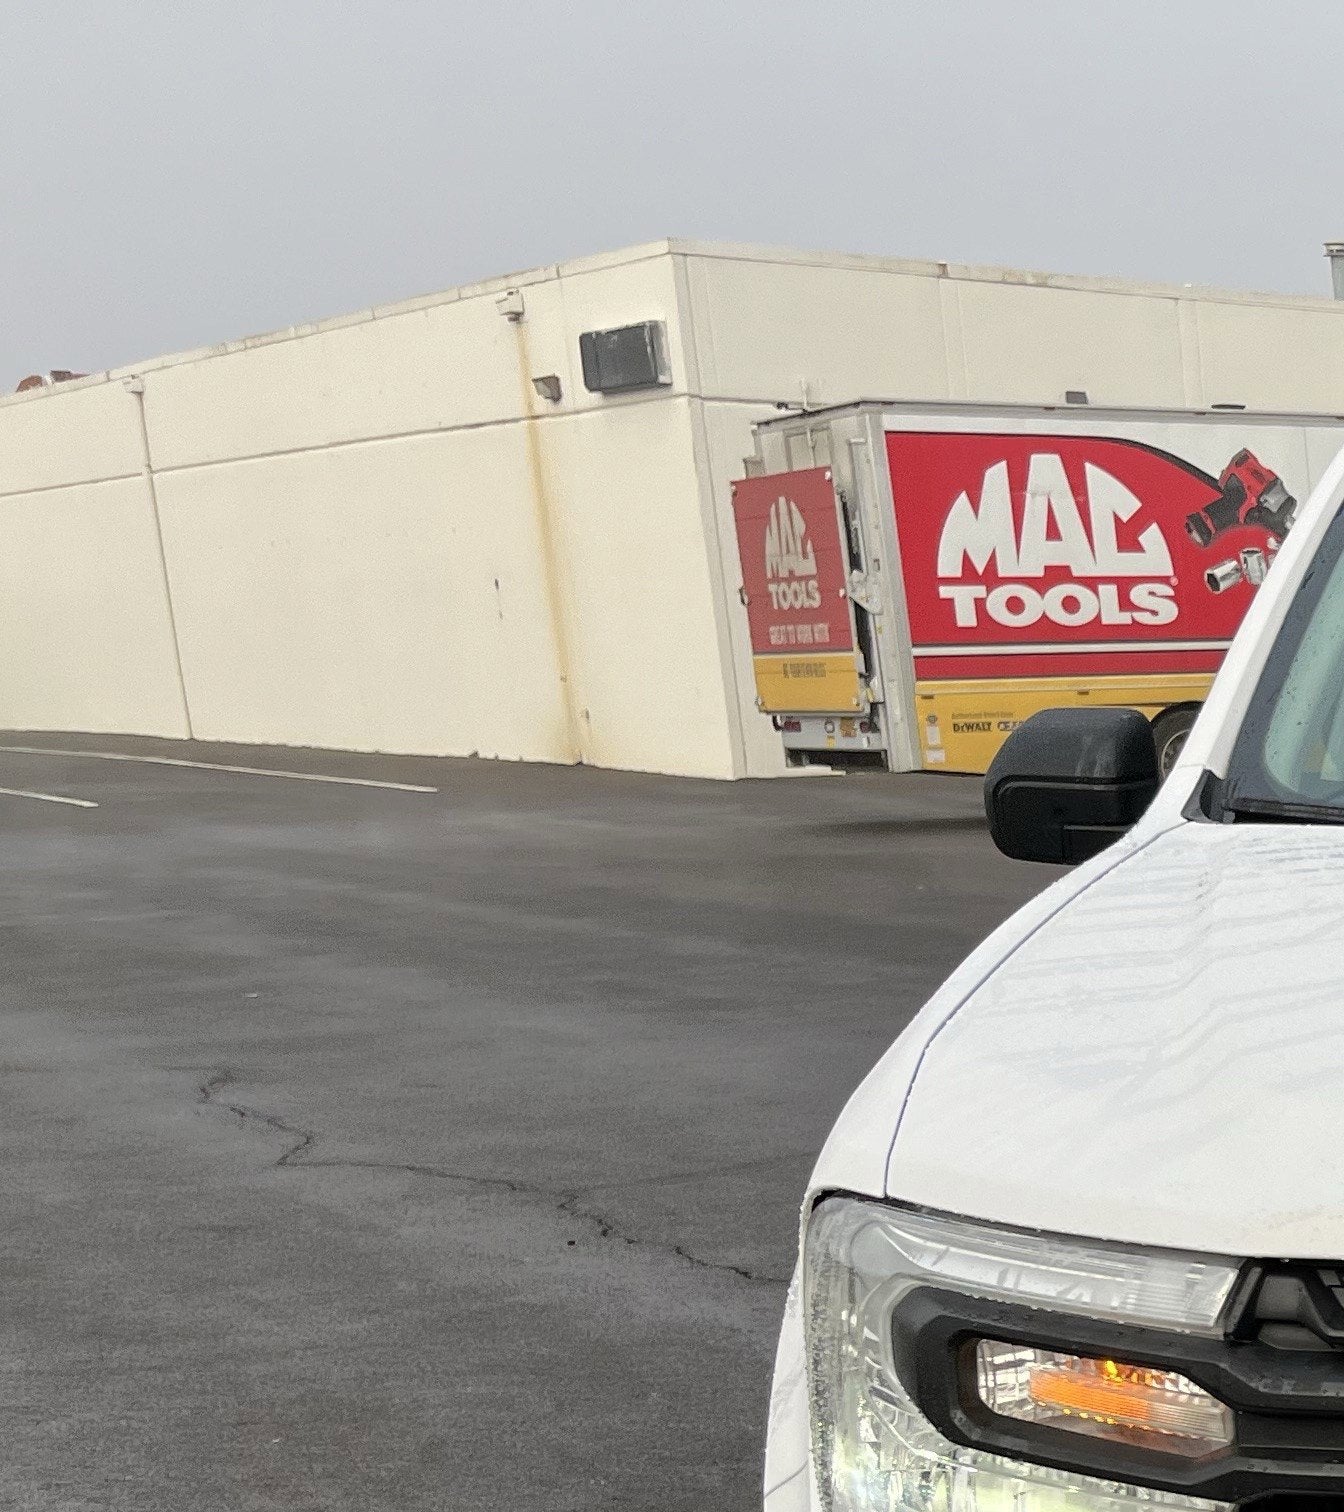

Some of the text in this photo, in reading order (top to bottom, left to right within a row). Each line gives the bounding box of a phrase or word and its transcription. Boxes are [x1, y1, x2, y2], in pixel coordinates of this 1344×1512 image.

[765, 496, 817, 579] MAC
[938, 453, 1175, 578] MAC
[768, 580, 821, 610] TOOLS
[939, 582, 1179, 628] TOOLS
